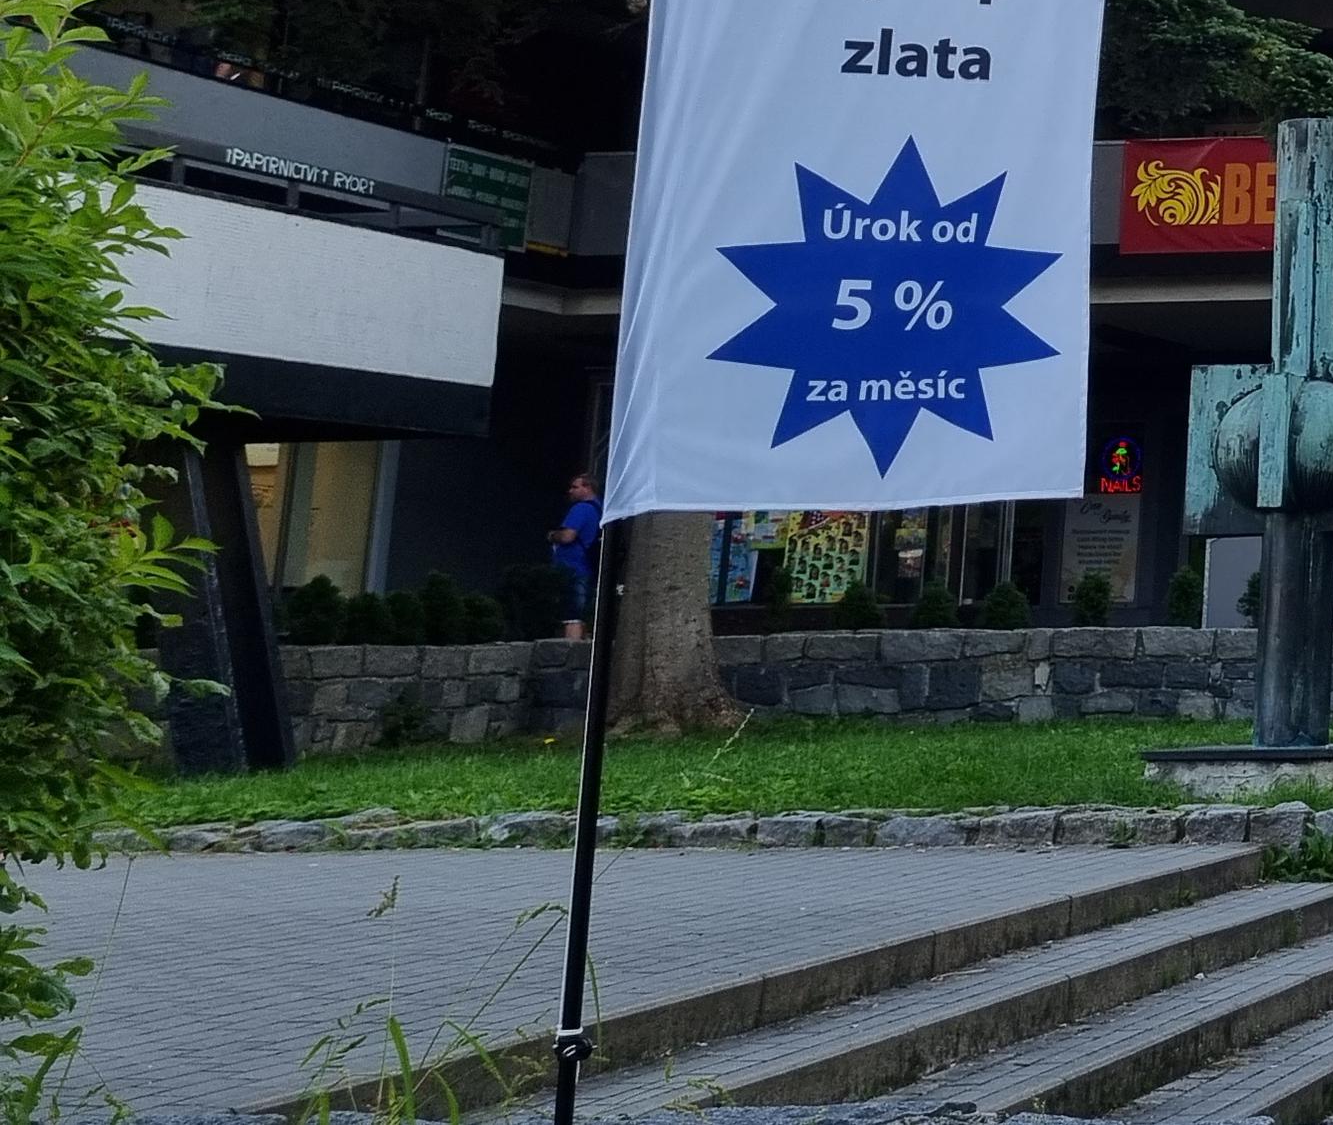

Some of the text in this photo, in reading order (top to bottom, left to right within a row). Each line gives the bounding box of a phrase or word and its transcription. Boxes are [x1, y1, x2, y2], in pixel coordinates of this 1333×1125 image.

[840, 28, 993, 81] zlata
[822, 203, 978, 245] Úrok od
[831, 280, 955, 332] 5 %
[806, 371, 966, 402] za měsíc
[1101, 475, 1142, 493] NAILS
